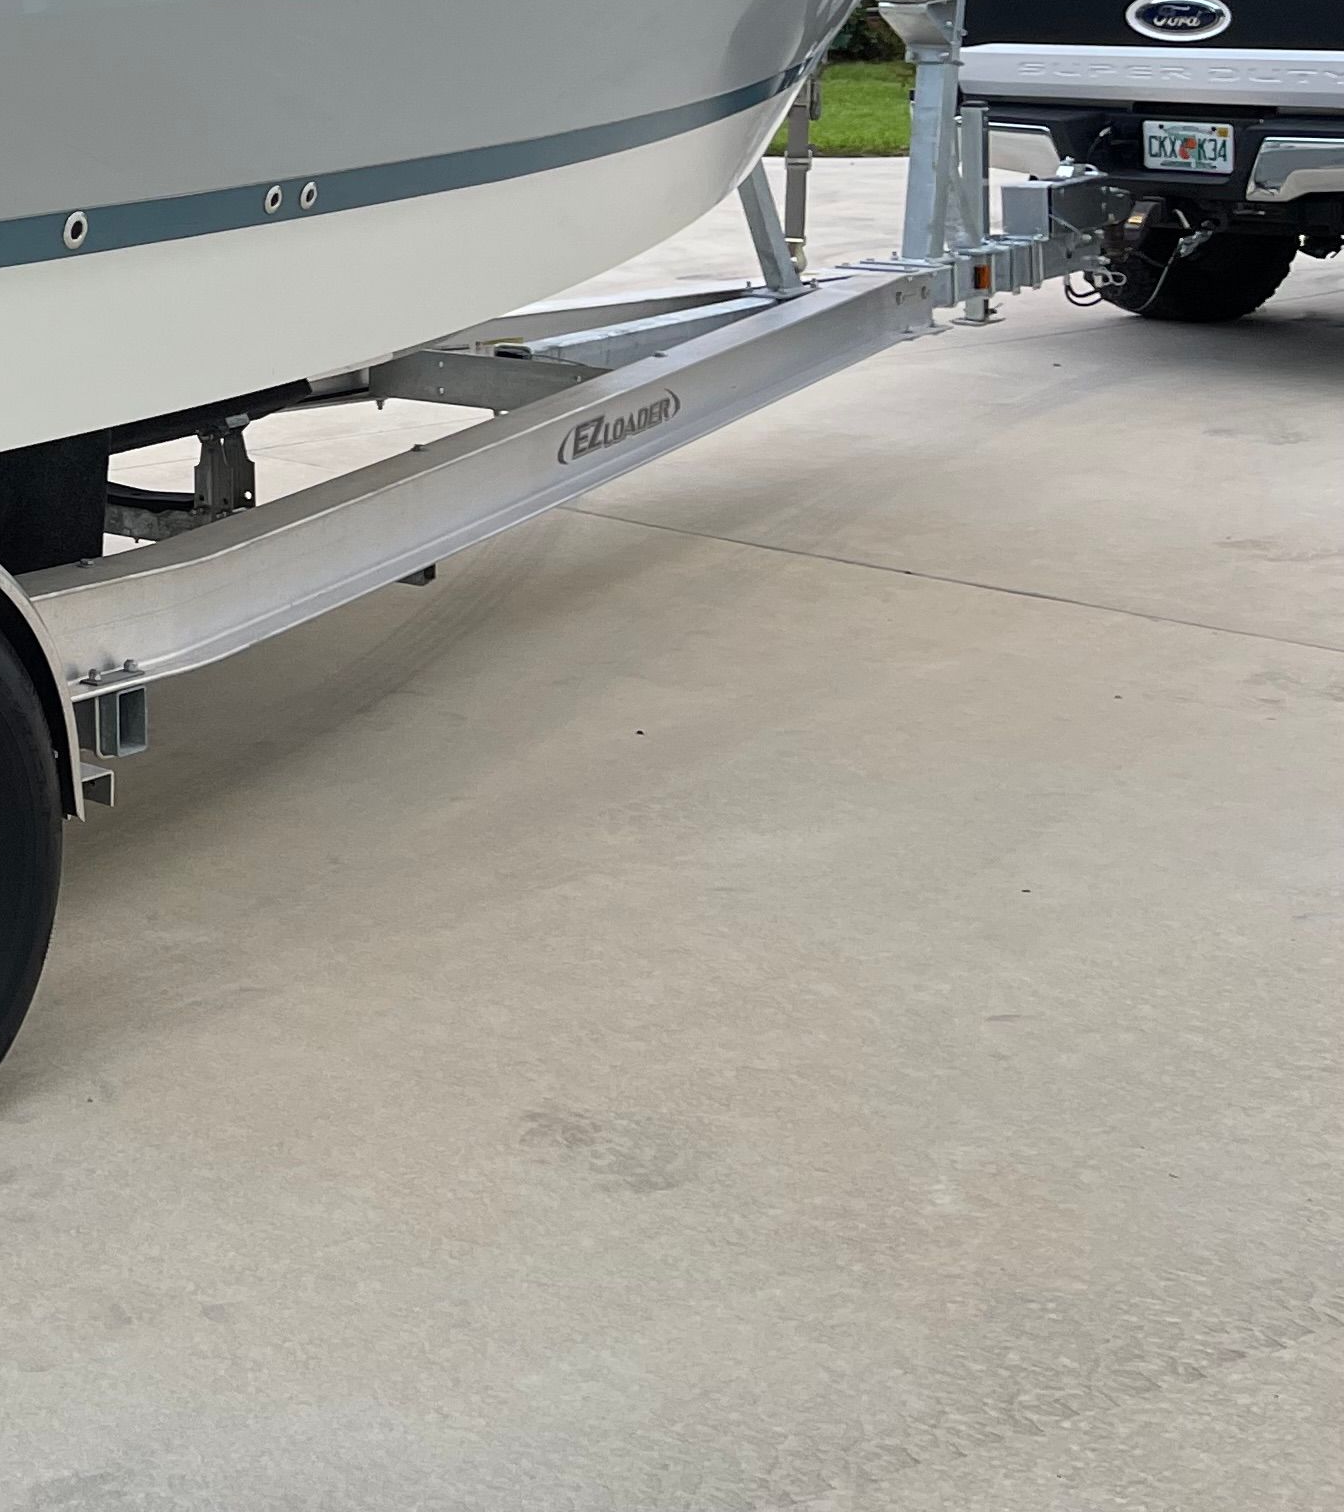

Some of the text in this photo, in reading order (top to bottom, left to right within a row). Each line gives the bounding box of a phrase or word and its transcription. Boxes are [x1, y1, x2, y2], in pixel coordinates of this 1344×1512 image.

[1153, 4, 1201, 27] Ford
[1017, 61, 1192, 81] SUPER
[1197, 138, 1227, 161] K34
